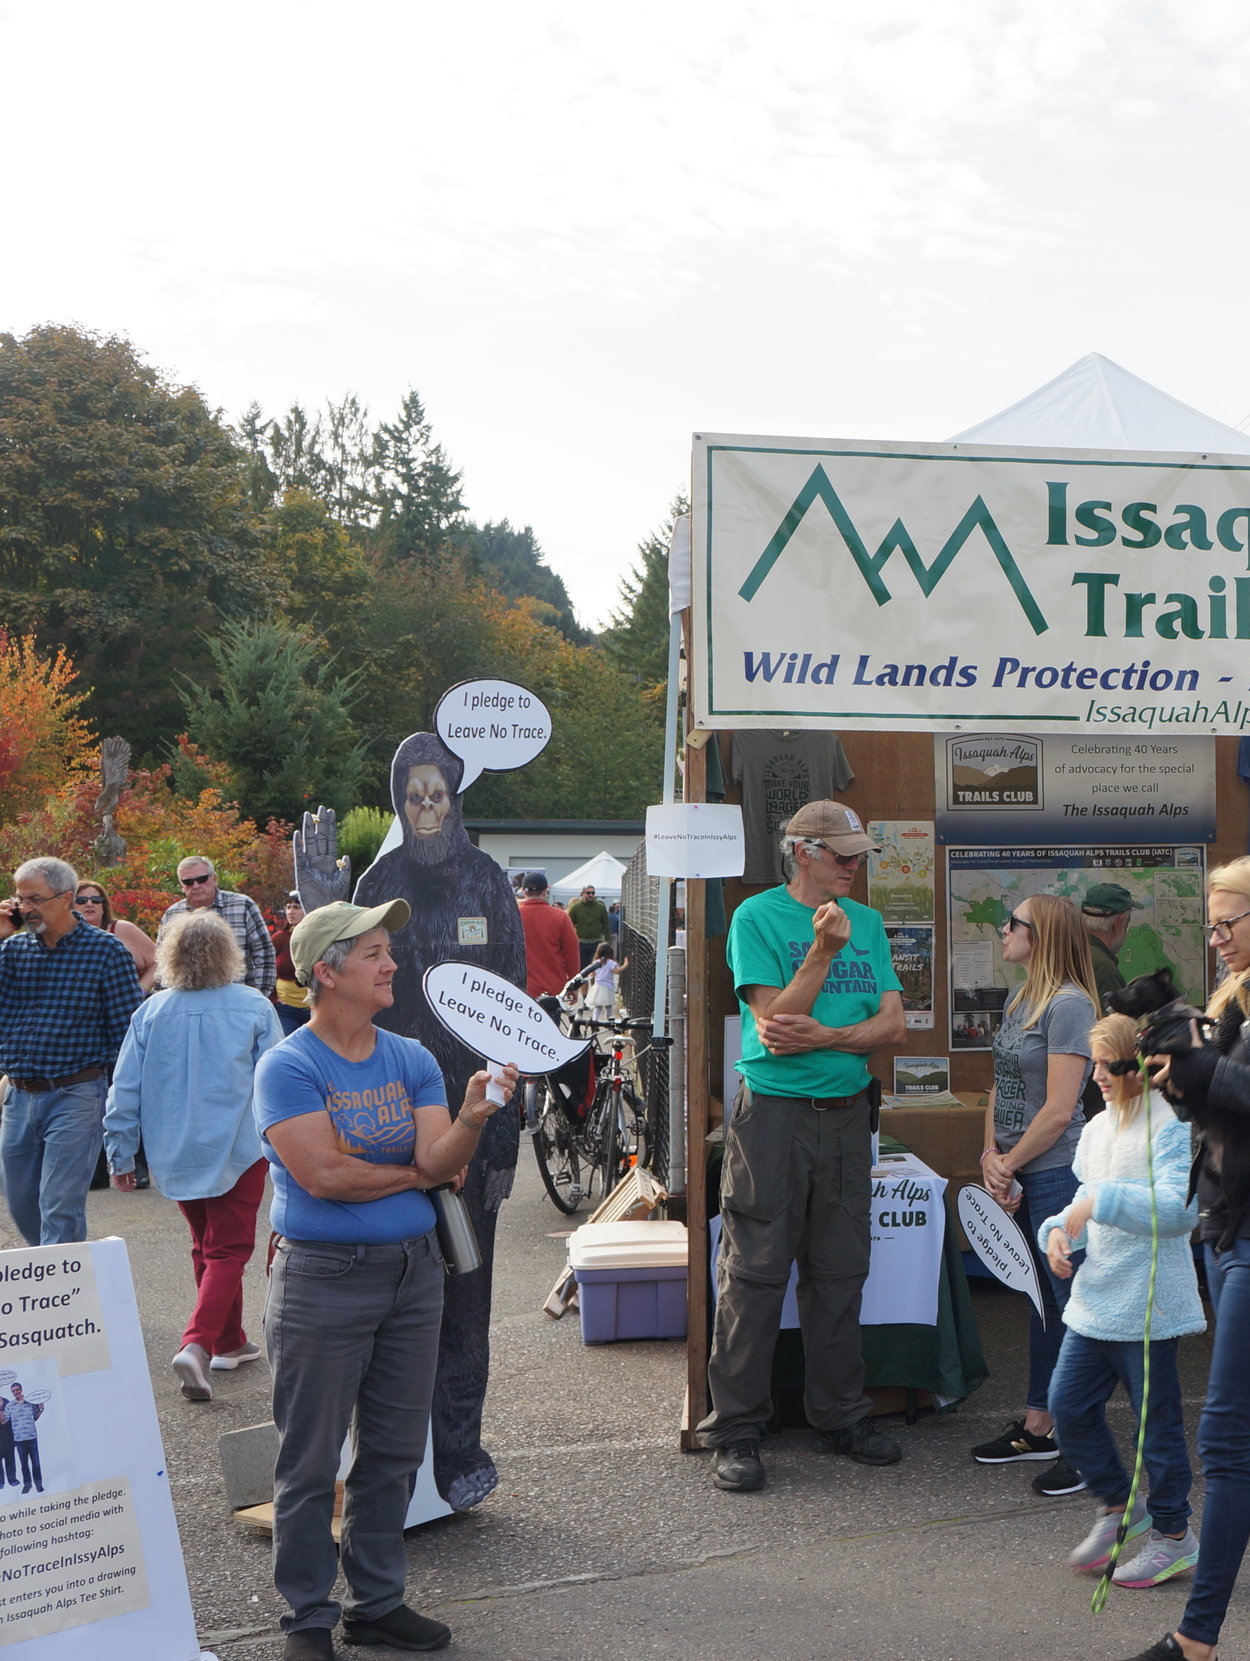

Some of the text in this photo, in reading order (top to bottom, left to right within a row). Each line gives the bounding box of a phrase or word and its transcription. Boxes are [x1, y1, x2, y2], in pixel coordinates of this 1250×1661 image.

[743, 651, 840, 685] Wild
[853, 655, 978, 688] Lands
[992, 656, 1199, 692] Protection
[464, 692, 531, 712] I pledge to
[448, 723, 547, 739] Leave No Trace.
[954, 745, 1035, 763] Issaquah Alps
[1071, 744, 1178, 756] Celebrating 40 Years
[1054, 763, 1195, 776] of advocacy for the special
[765, 788, 809, 801] WORLD
[957, 791, 1034, 802] TRAILS CLUB
[1092, 783, 1159, 795] place we call
[1062, 804, 1189, 818] The Issaquah Alps
[1047, 849, 1085, 858] ISSAQUAH
[1151, 848, 1173, 856] (IATC)
[892, 953, 920, 962] ANSIT
[461, 972, 543, 1023] I pledge to
[438, 990, 560, 1062] Leave No Trace.
[377, 1097, 413, 1125] ALP
[891, 1179, 931, 1207] Alps
[878, 1210, 927, 1228] CLUB
[965, 1188, 1031, 1275] Leave No Trace.
[966, 1220, 1012, 1279] I pledge to
[62, 1260, 81, 1274] to
[1, 1302, 13, 1315] o
[0, 1318, 101, 1348] Sasquatch.
[9, 1507, 37, 1521] while
[39, 1500, 71, 1513] taking
[73, 1496, 90, 1507] the
[92, 1489, 126, 1504] pledge.
[0, 1504, 124, 1540] hoto to social media with
[0, 1528, 94, 1559] following hashtag:
[0, 1544, 125, 1582] NoTraceInIssyAlps
[9, 1589, 43, 1604] enters
[45, 1583, 64, 1597] you
[66, 1577, 86, 1590] into
[88, 1577, 95, 1586] a
[97, 1566, 136, 1582] drawing
[6, 1602, 53, 1623] Issaquah
[55, 1597, 77, 1610] Alps
[80, 1591, 97, 1603] Tee
[99, 1585, 124, 1598] Shirt.
